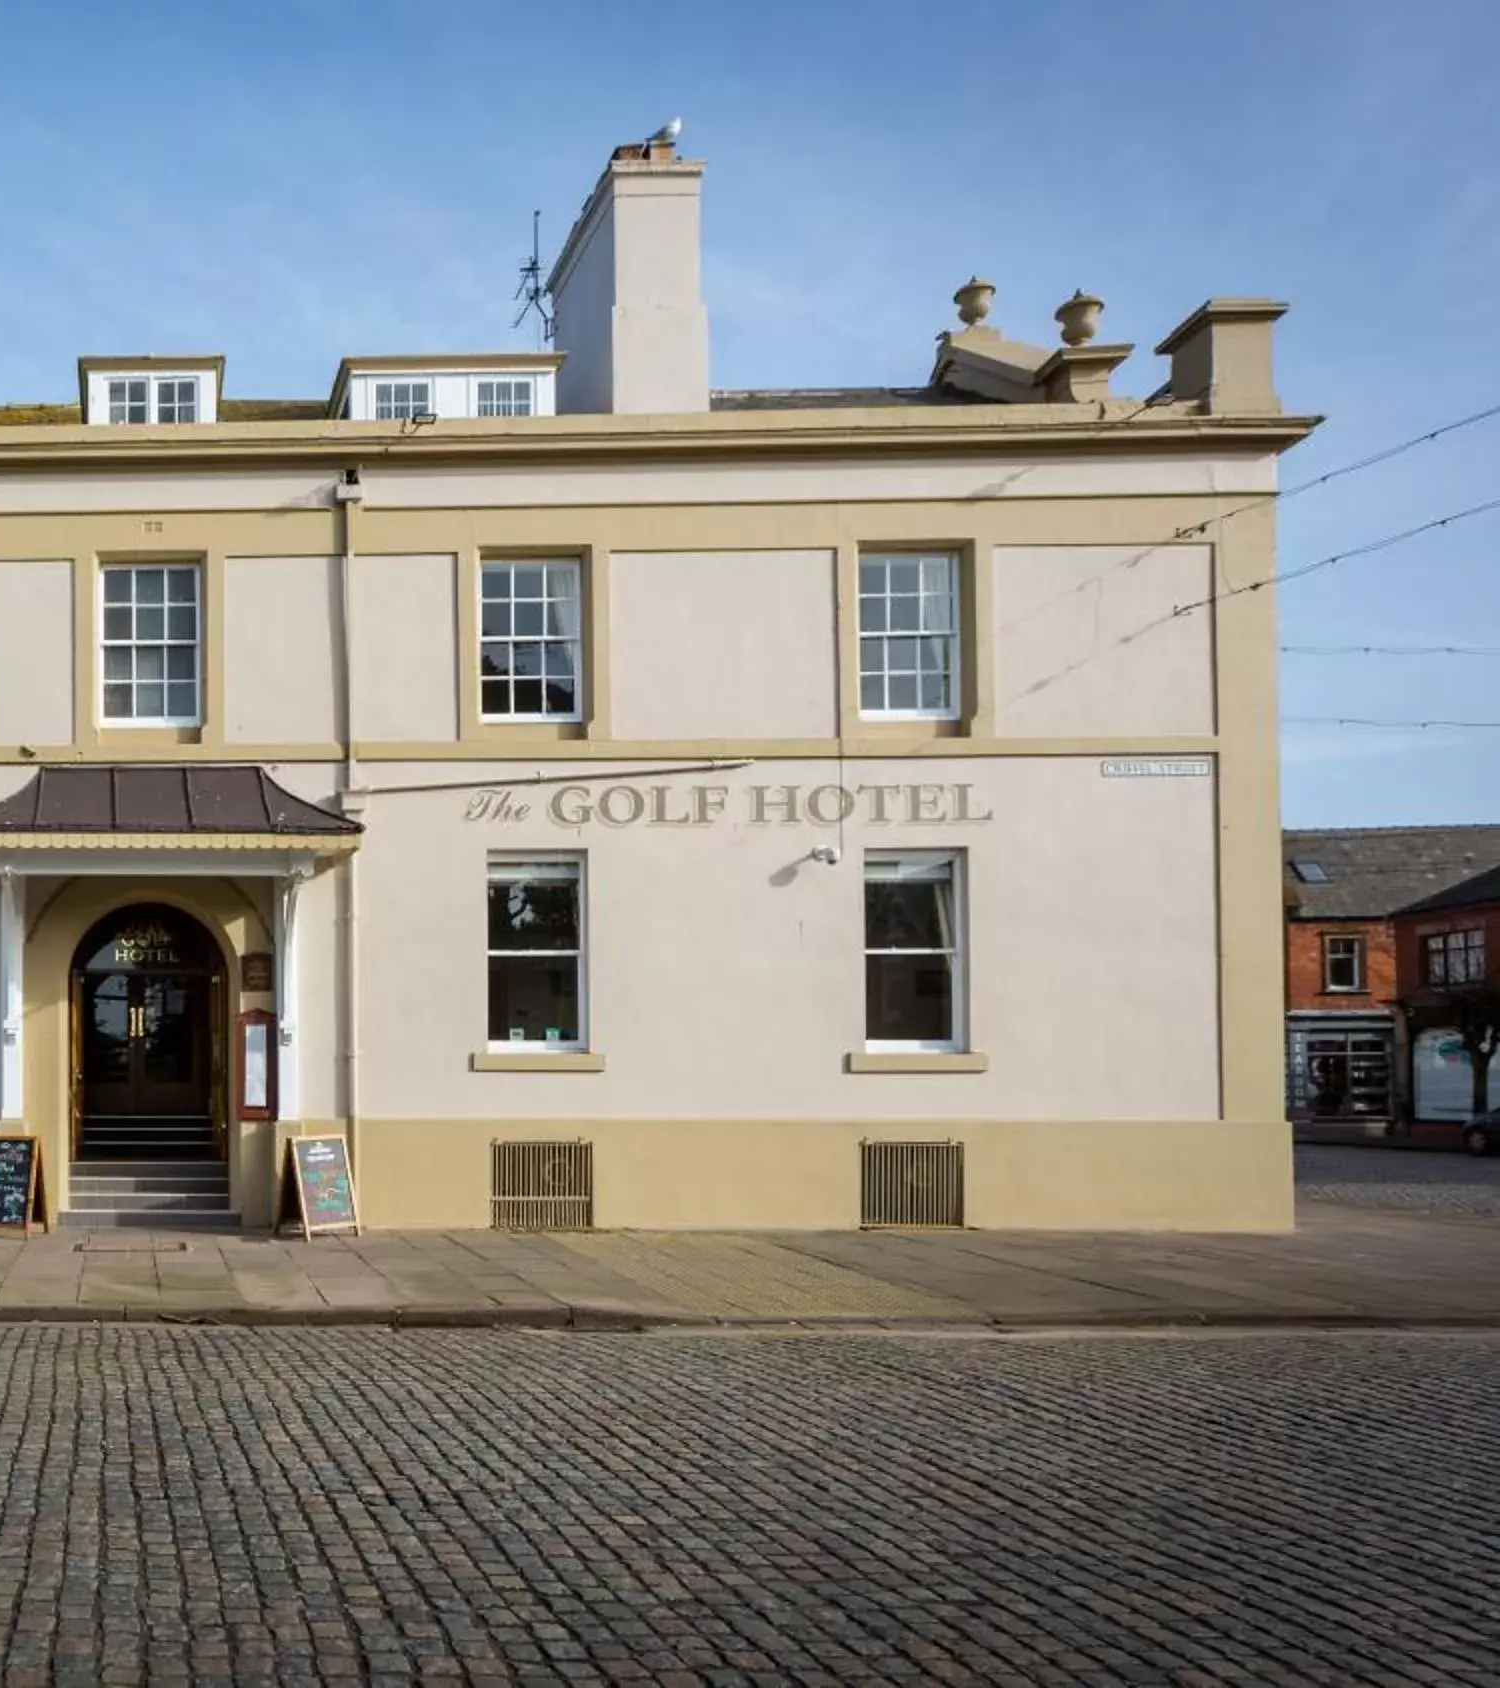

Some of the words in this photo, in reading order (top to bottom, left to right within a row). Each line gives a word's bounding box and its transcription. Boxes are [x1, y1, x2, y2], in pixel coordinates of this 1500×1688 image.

[462, 788, 530, 823] The
[547, 784, 729, 828] GOLF
[746, 783, 994, 828] HOTEL
[115, 949, 180, 962] HOTEL
